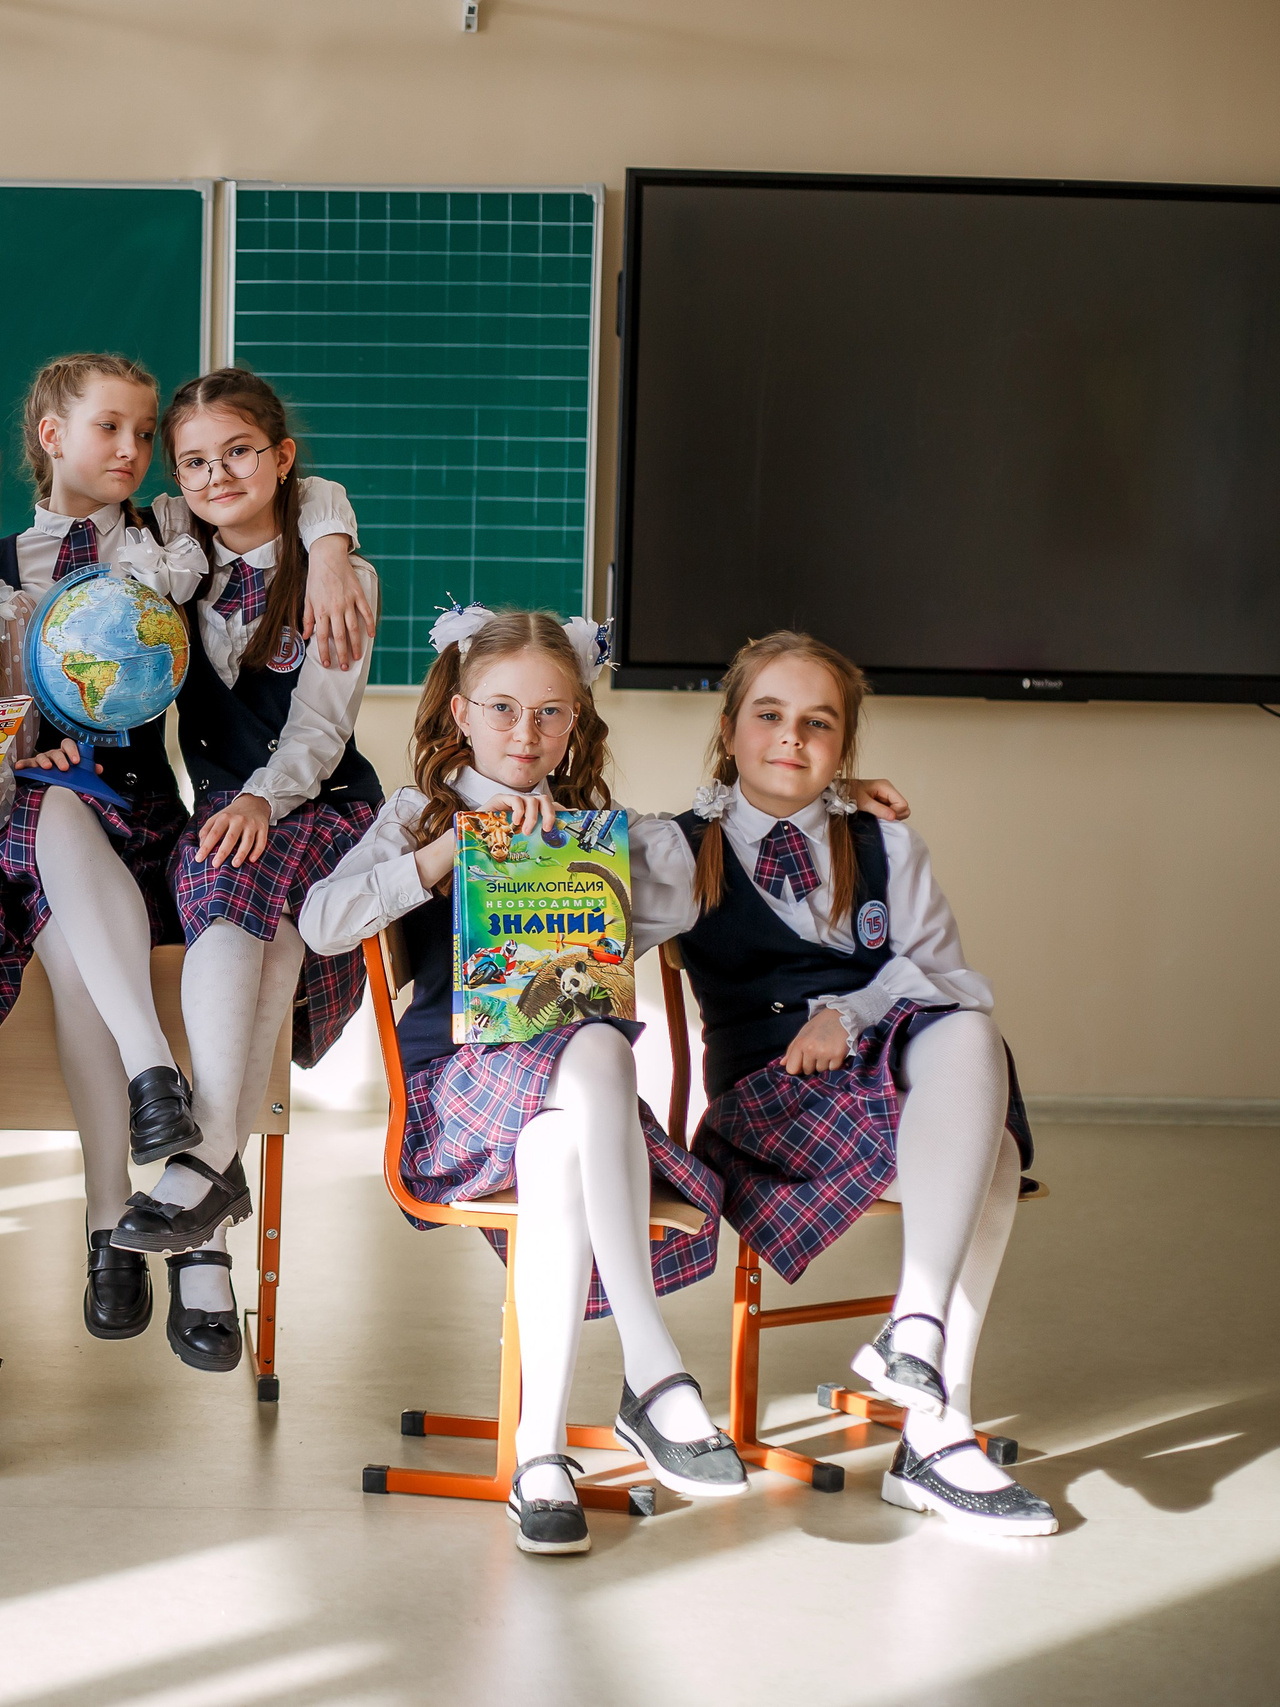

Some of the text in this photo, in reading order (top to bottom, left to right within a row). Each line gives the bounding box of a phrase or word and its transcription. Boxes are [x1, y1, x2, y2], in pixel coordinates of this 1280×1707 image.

[486, 881, 604, 894] ЭНЦИКЛОПЕДИЯ
[486, 899, 605, 908] НЕОБХОДИМЫХ
[488, 906, 605, 936] ЗНАНИЙ
[866, 916, 882, 934] 15
